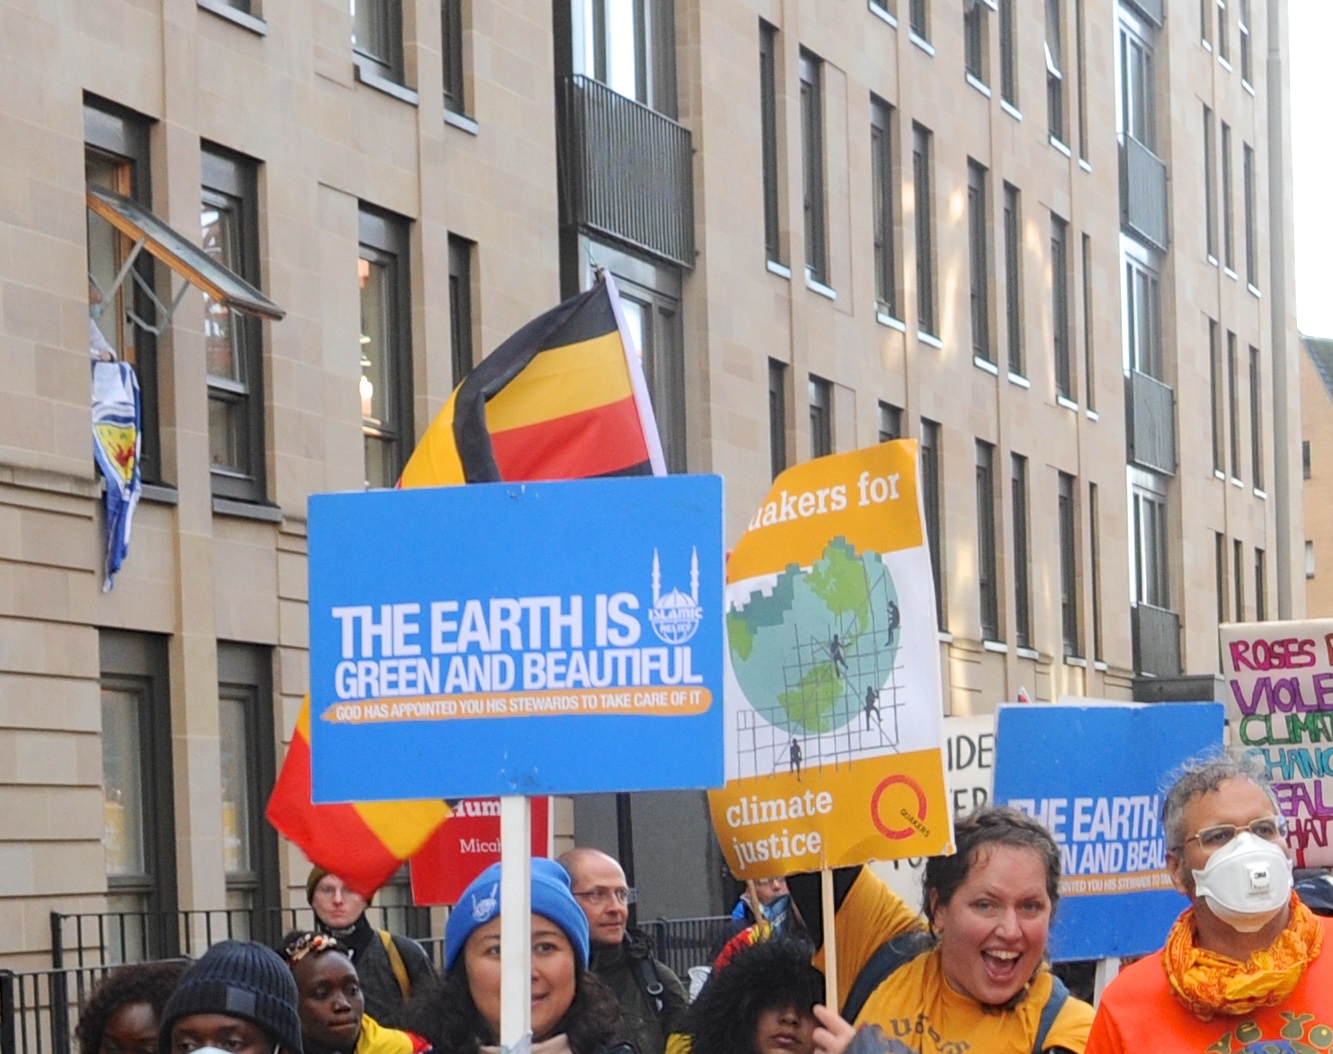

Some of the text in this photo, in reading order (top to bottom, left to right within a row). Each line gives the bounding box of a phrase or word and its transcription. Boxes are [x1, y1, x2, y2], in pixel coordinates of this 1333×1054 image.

[748, 471, 900, 531] uakers for
[331, 592, 641, 659] THE EARTH IS
[335, 646, 703, 699] GREEN AND BEAUTIFUL
[1229, 638, 1316, 672] ROSES
[336, 690, 702, 721] GOD HAS APPOINTED YOU HIS STEWARDS TO TAKE CARE OF IT
[726, 789, 834, 828] climate
[900, 808, 931, 838] QUAKERS
[1073, 794, 1160, 842] EARTH
[732, 828, 822, 871] justice
[1079, 841, 1125, 875] AND
[1126, 838, 1167, 872] BEAU
